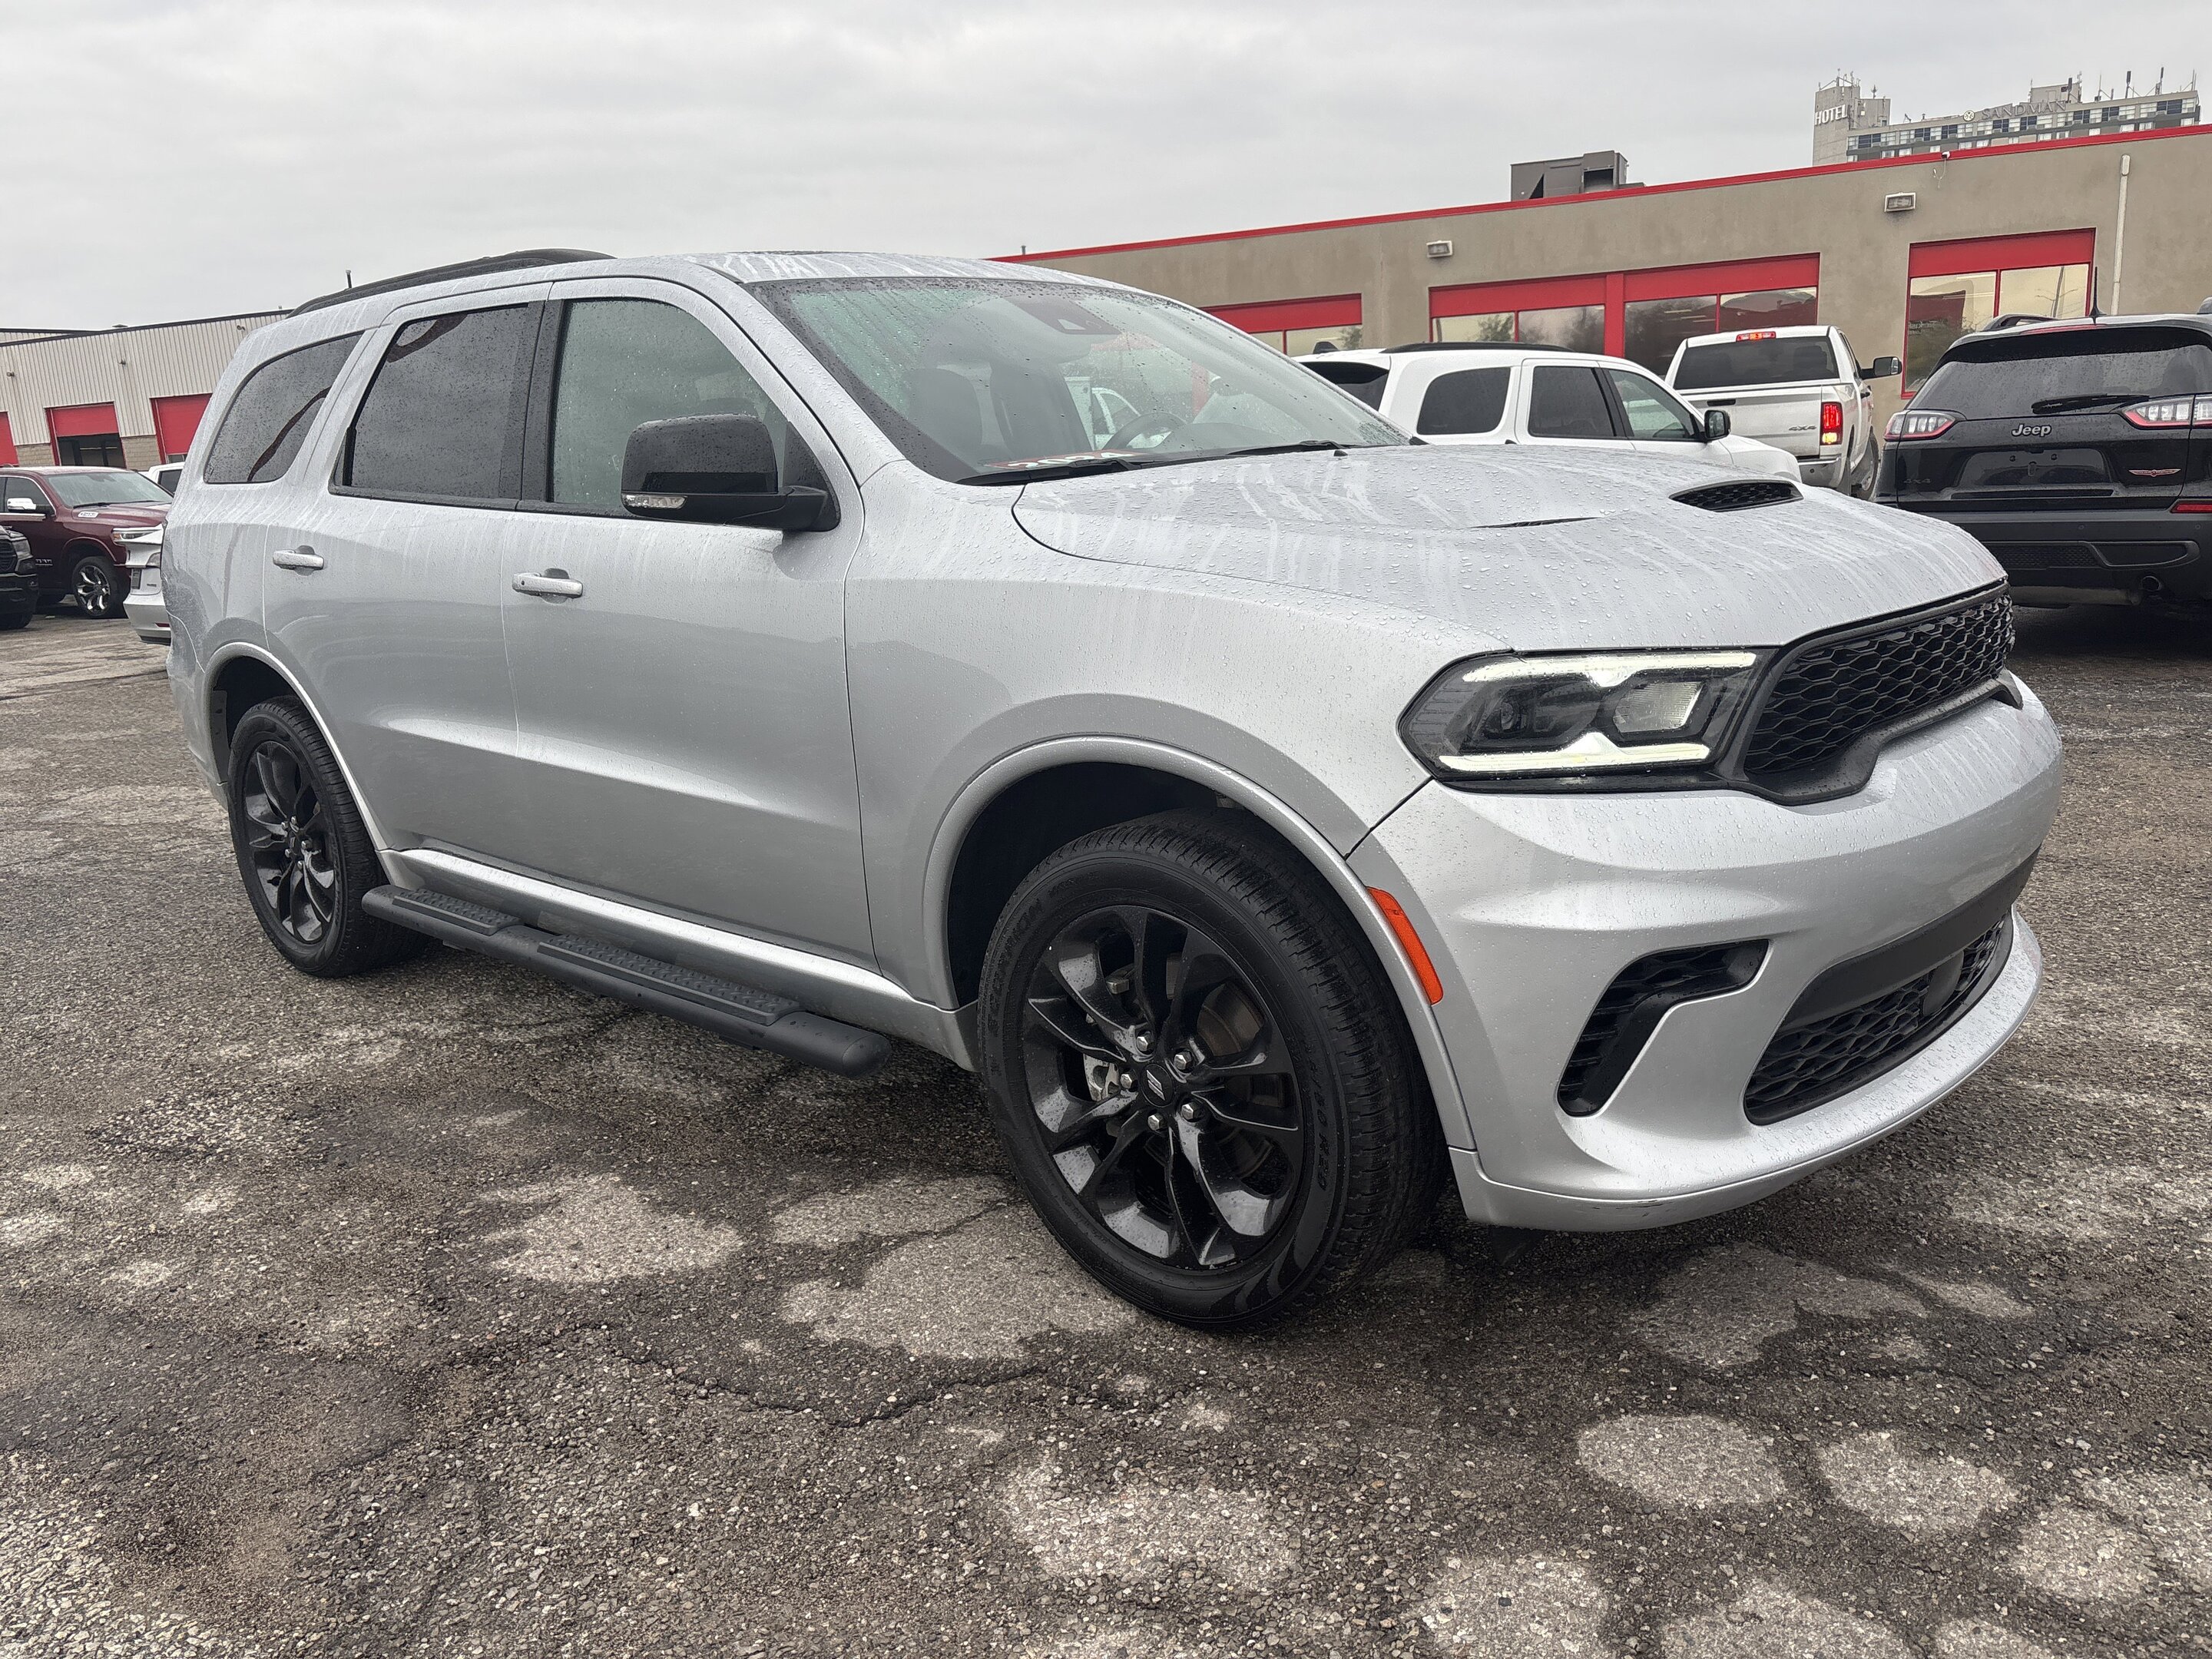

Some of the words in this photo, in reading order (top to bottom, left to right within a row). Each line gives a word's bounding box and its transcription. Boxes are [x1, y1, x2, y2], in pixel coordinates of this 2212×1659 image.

[1814, 104, 1848, 125] HOTEL
[1982, 100, 2068, 121] SANDMAN
[2012, 423, 2051, 437] Jeep
